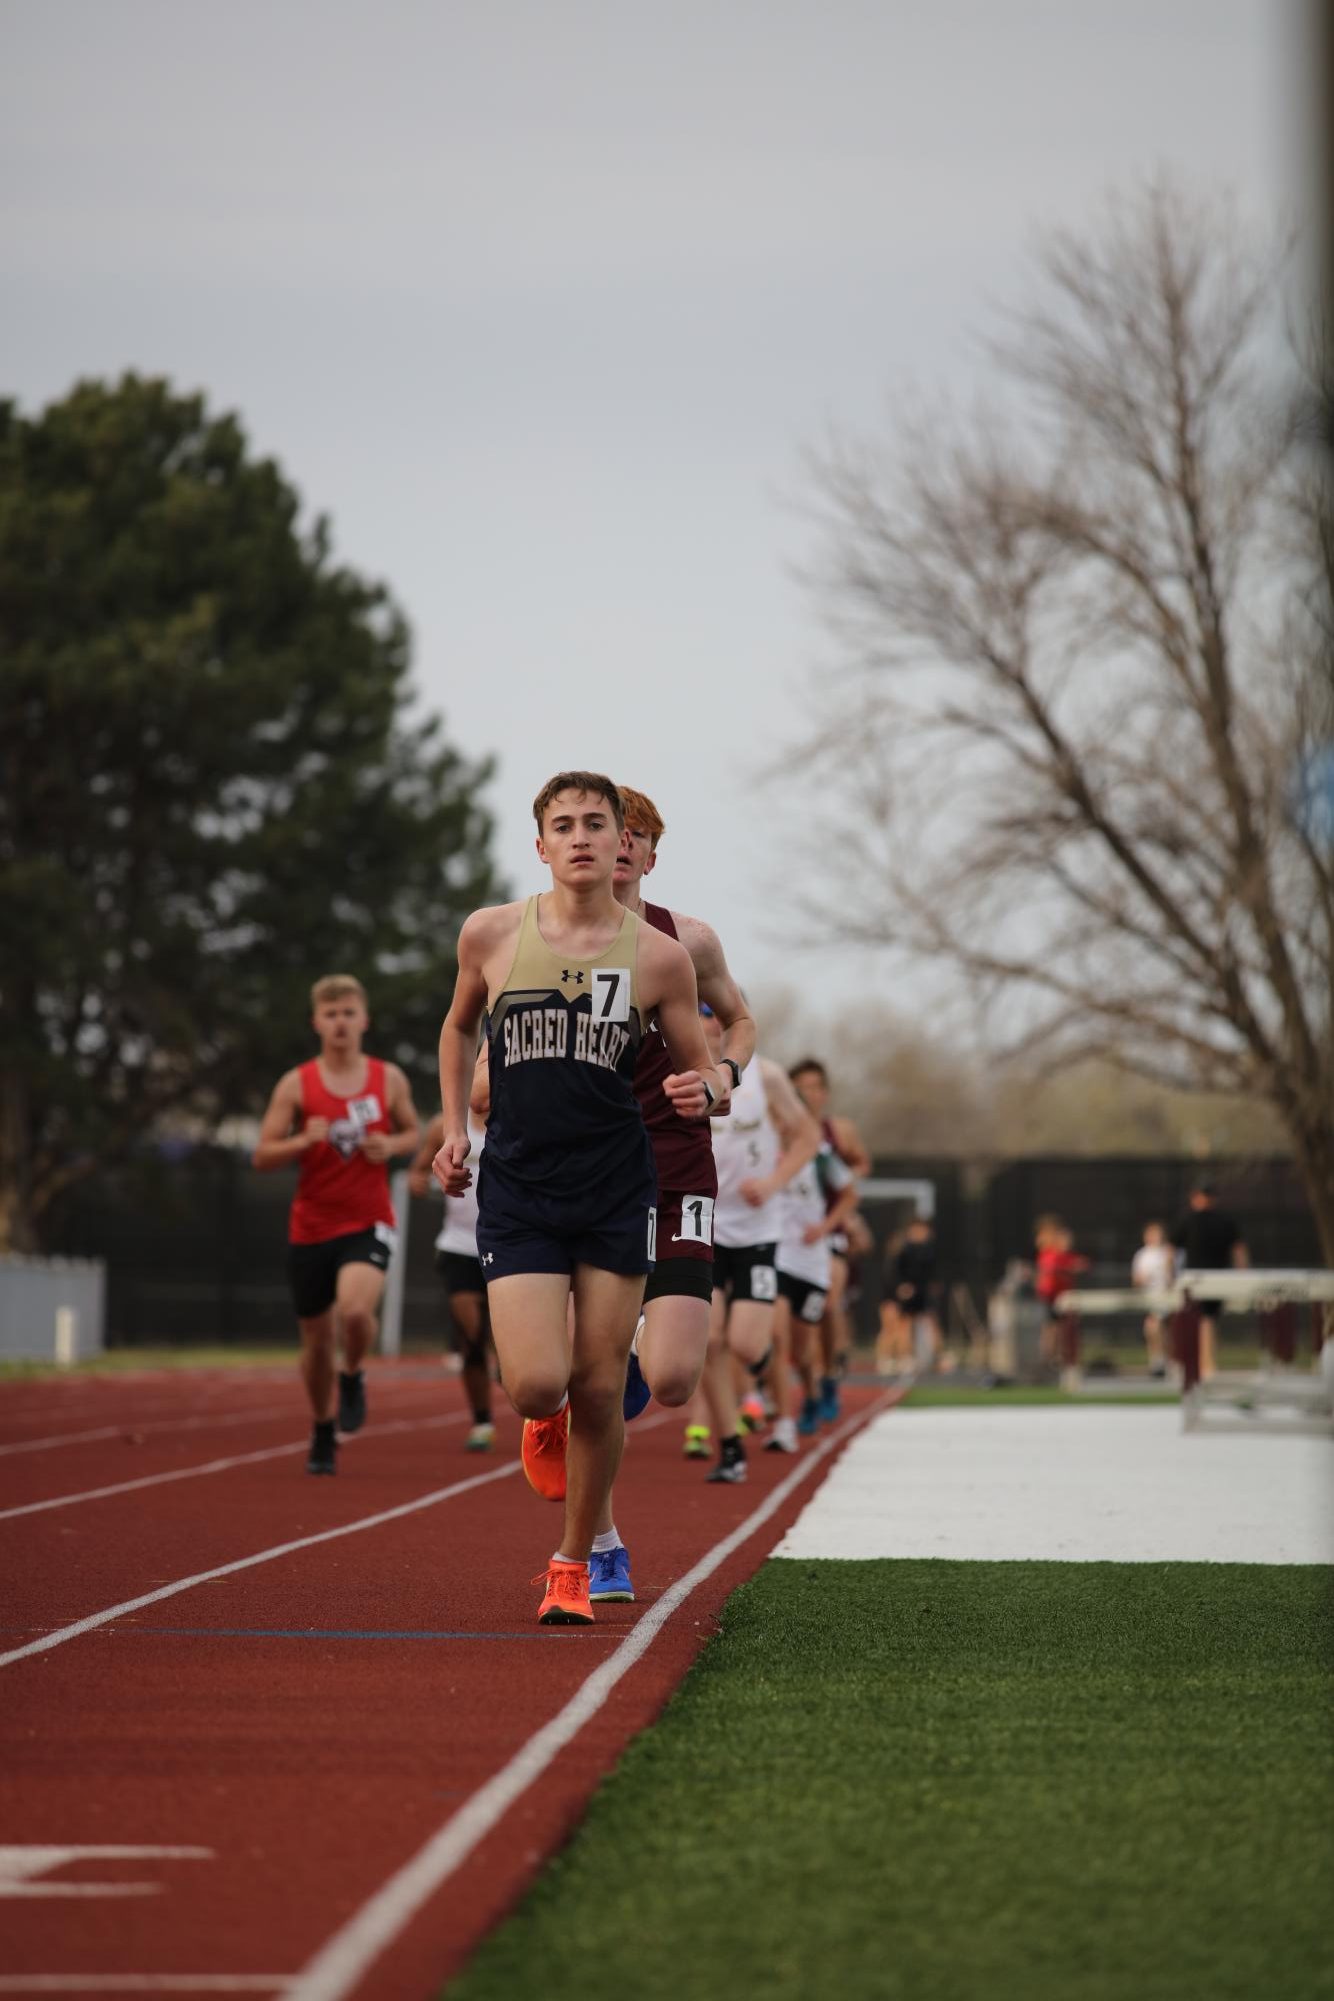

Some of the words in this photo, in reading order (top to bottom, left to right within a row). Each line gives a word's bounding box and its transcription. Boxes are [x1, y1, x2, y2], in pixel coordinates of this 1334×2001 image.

[597, 974, 620, 1017] 7
[504, 1008, 568, 1068] SACRED
[687, 1200, 703, 1237] 1
